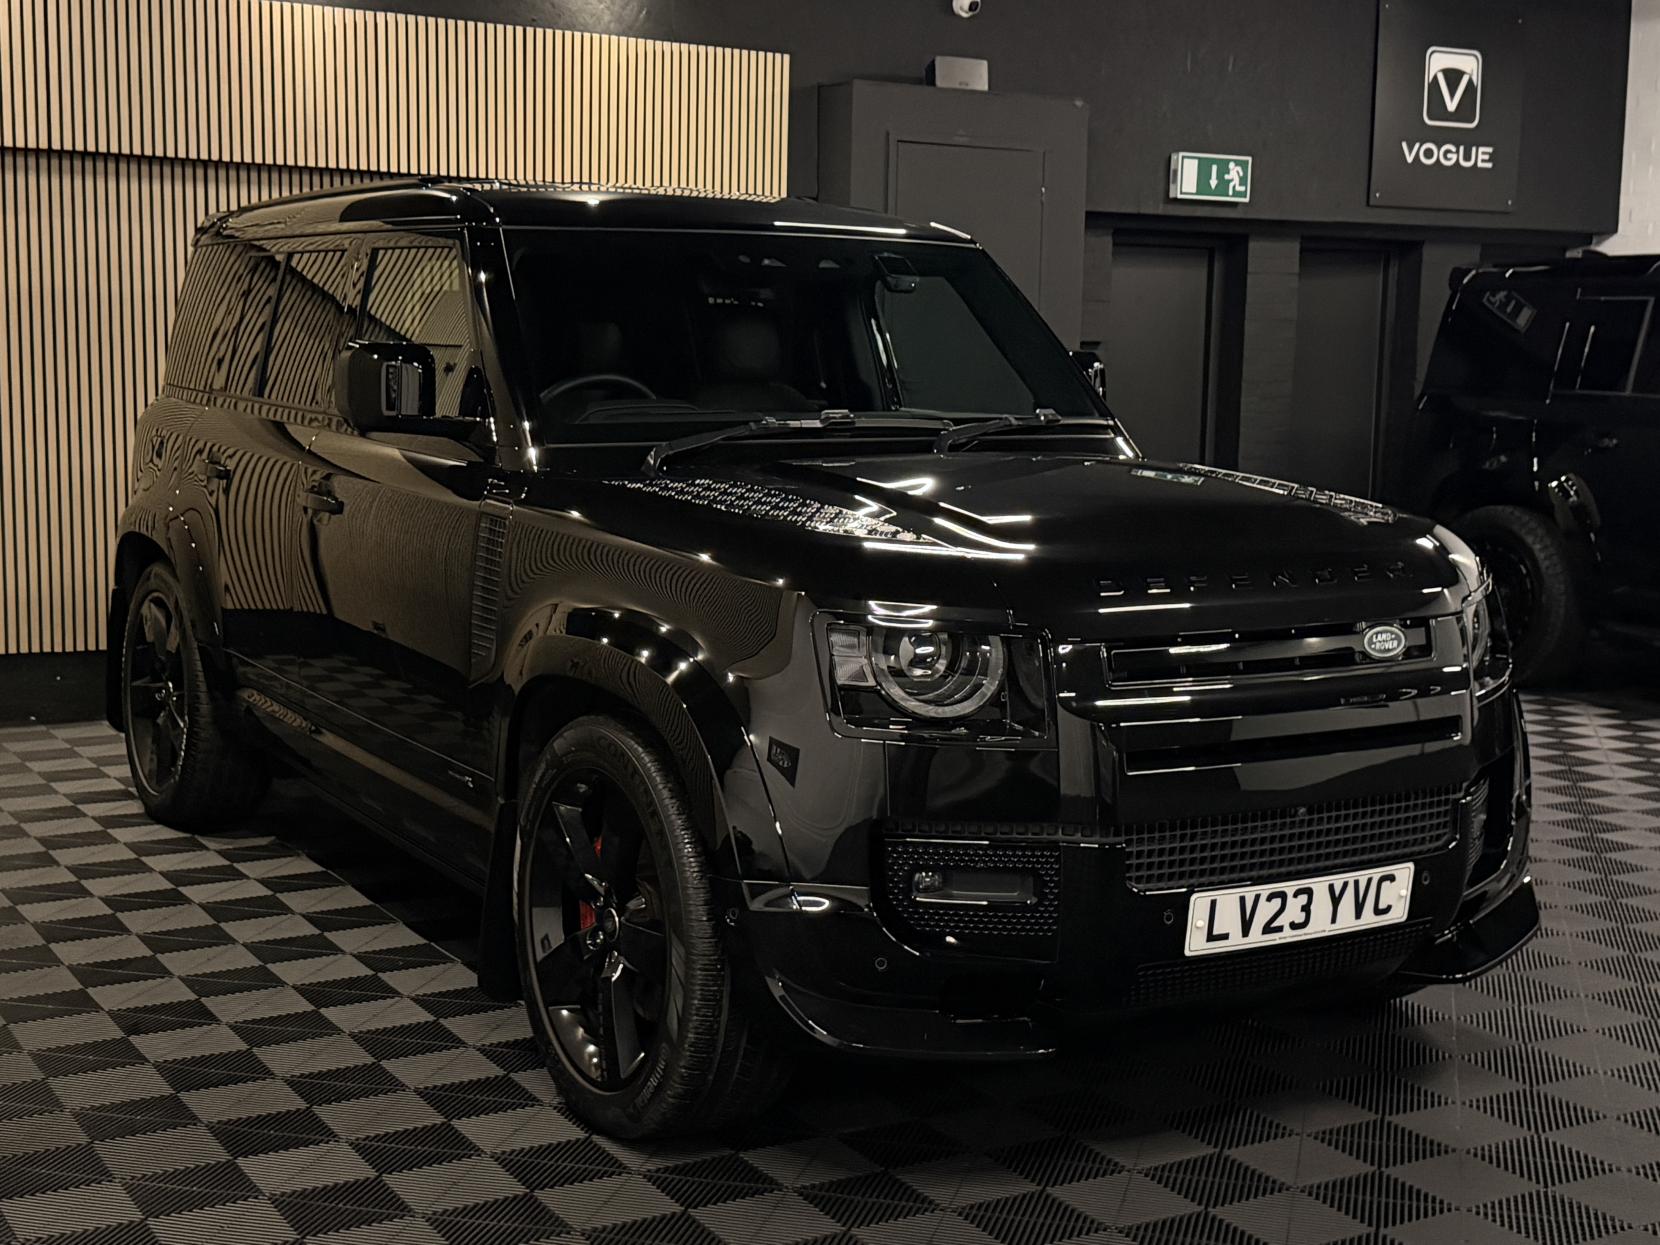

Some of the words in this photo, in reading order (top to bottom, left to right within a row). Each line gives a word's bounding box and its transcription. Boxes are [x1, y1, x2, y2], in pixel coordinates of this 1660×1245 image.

[1436, 70, 1471, 112] V
[1401, 141, 1493, 168] VOGUE
[1098, 561, 1413, 598] DEFENDER
[1372, 632, 1392, 642] LAND
[1375, 640, 1398, 650] ROVER
[1205, 886, 1314, 943] LV23
[1328, 873, 1396, 925] YVC
